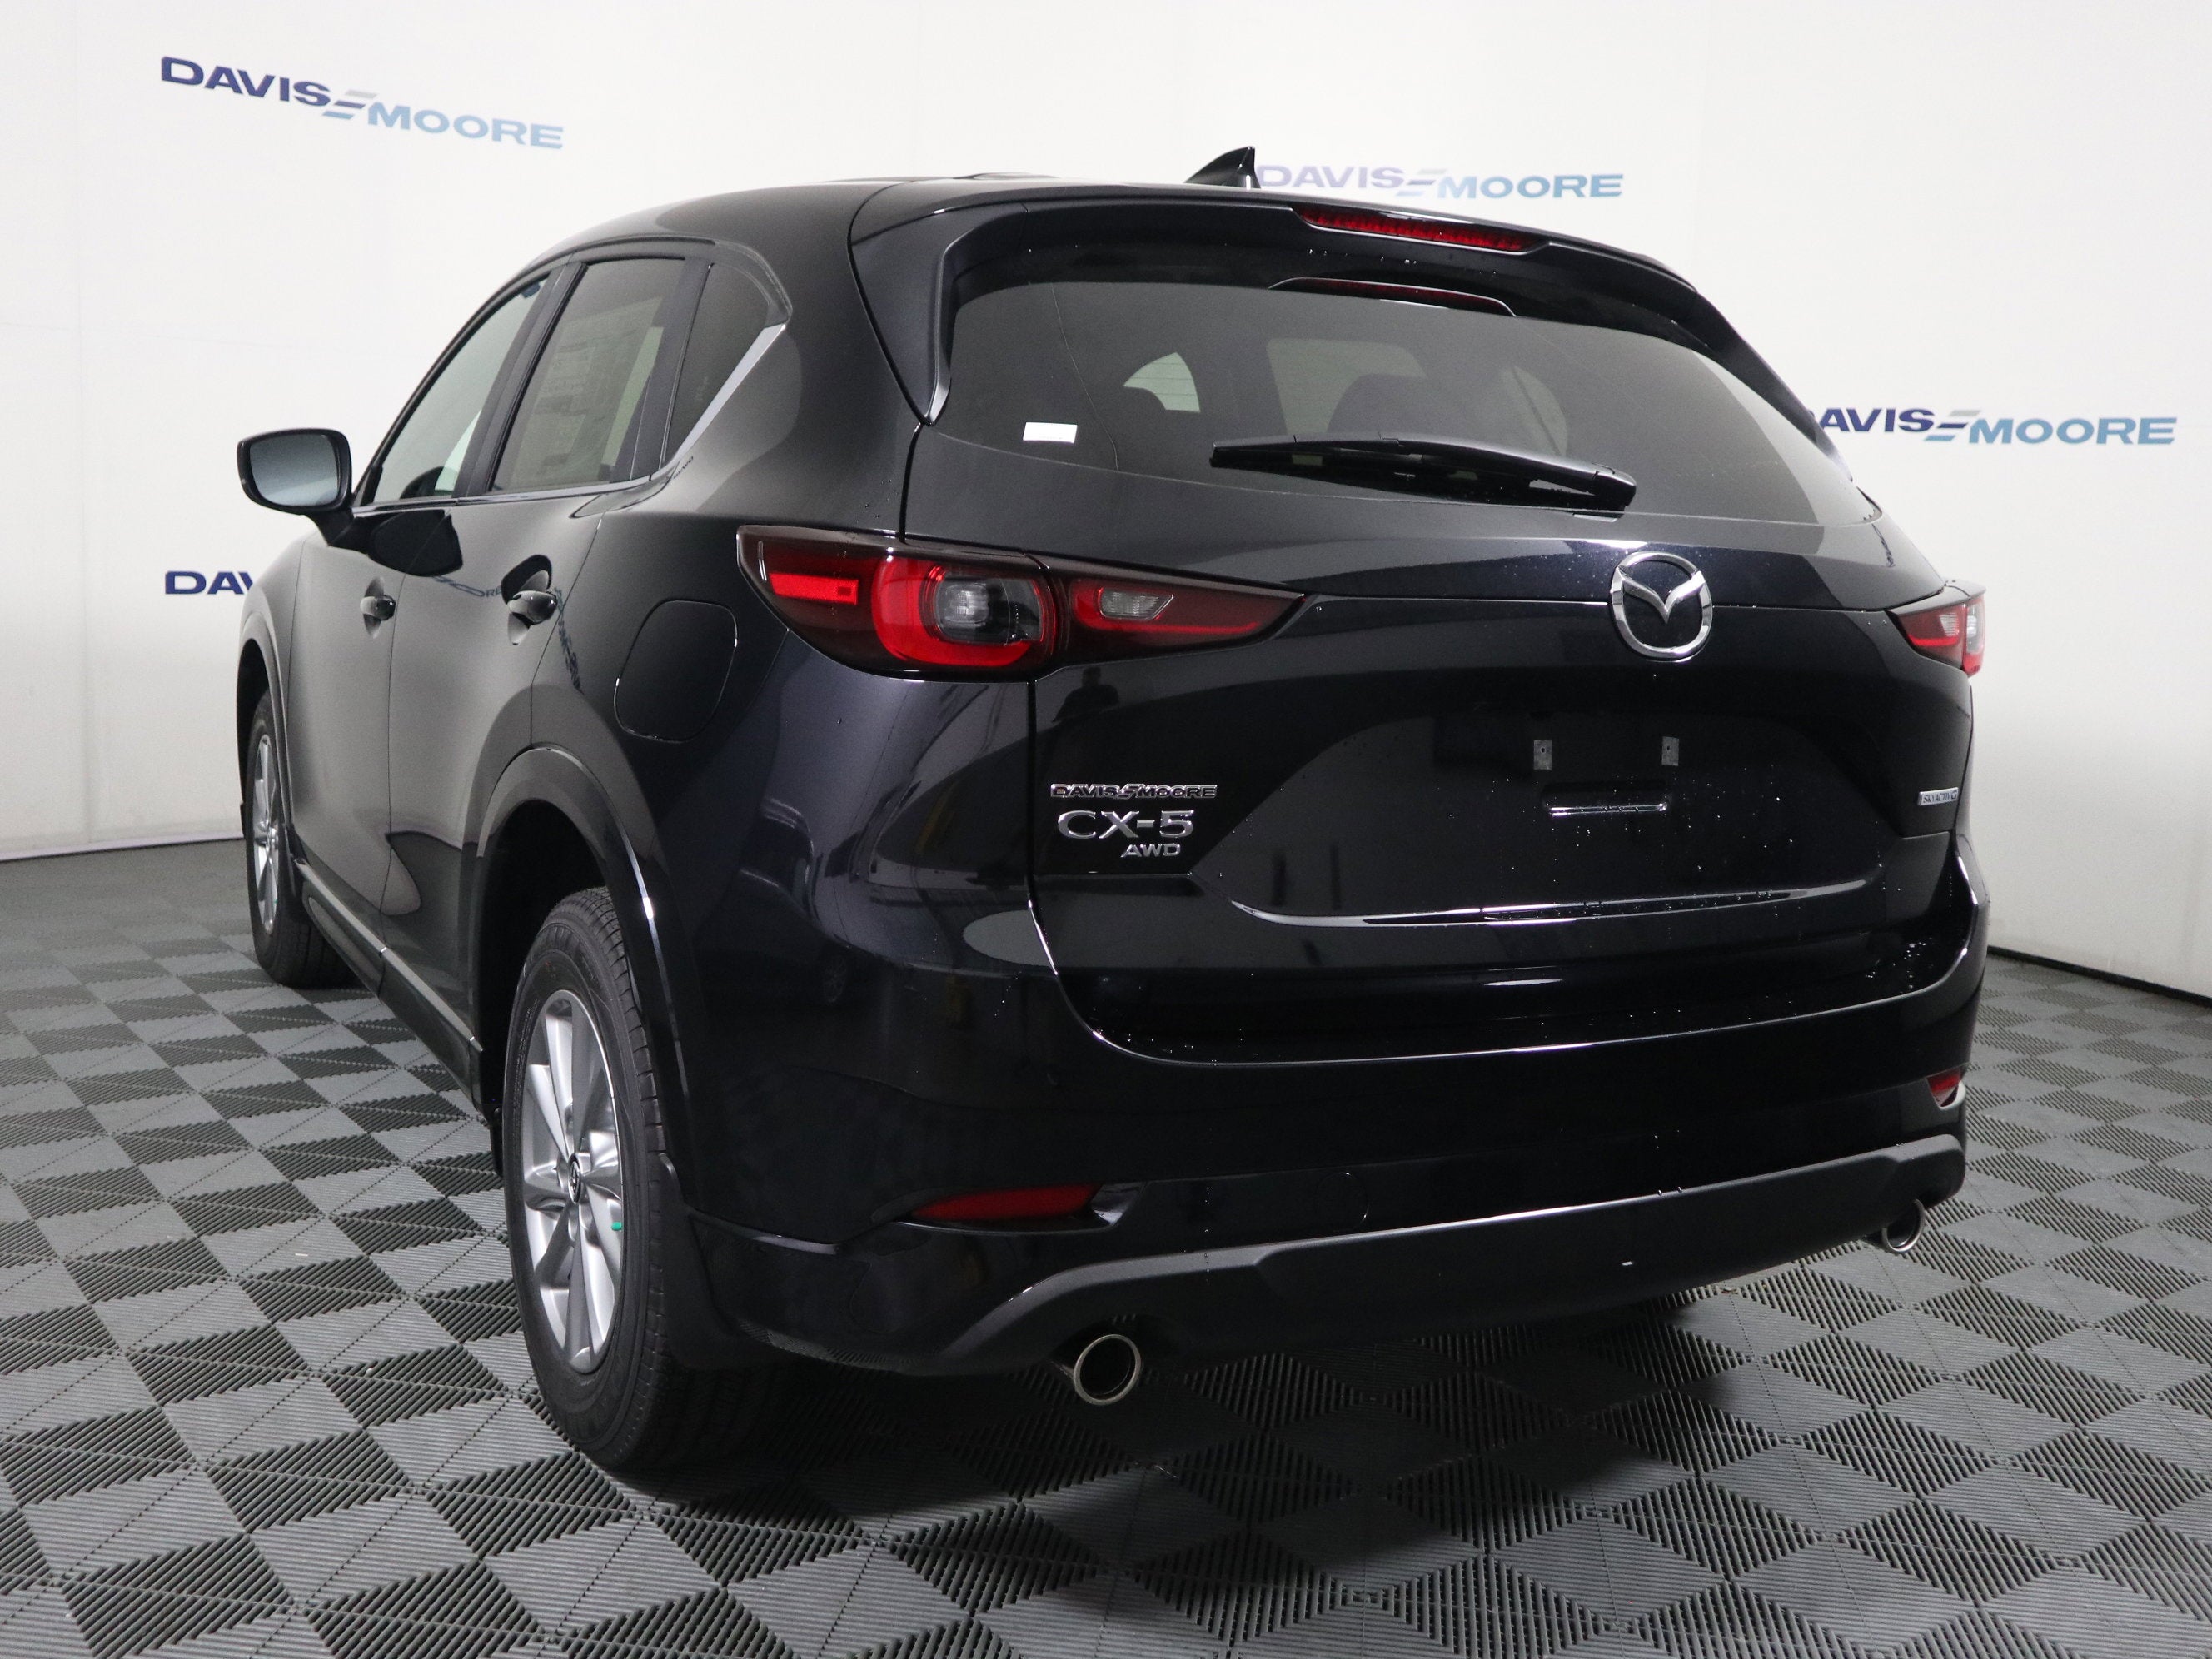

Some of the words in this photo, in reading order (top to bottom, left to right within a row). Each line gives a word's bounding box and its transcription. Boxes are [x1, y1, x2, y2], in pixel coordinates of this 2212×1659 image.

[161, 56, 331, 107] DAVIS
[367, 102, 564, 150] MOORE
[1257, 165, 1404, 189] DAVIS
[1437, 173, 1624, 198] MOORE
[1808, 408, 1936, 432] AVIS
[1969, 417, 2177, 445] MOORE
[1050, 783, 1123, 799] DAVIS
[1058, 810, 1194, 839] CX-5
[1121, 843, 1181, 858] AWD
